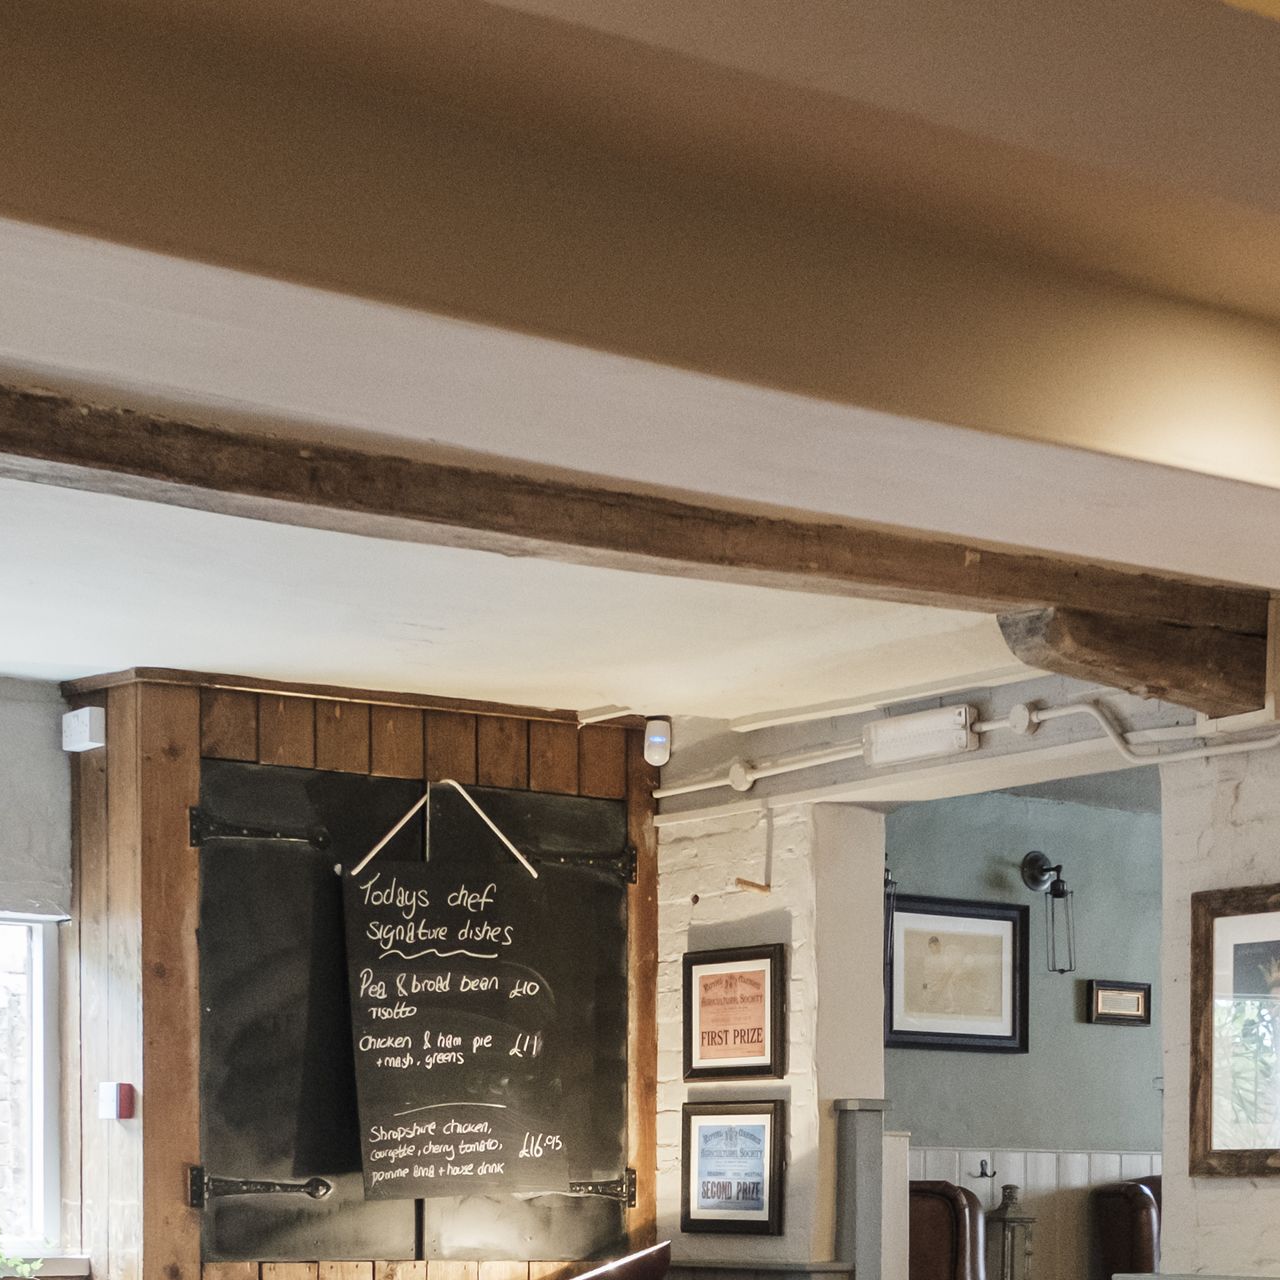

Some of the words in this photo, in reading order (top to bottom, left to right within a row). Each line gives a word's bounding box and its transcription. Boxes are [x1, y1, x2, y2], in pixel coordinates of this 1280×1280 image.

[360, 873, 430, 919] Todays
[448, 883, 497, 912] chef
[458, 920, 513, 945] dishes
[360, 968, 387, 999] Pea
[396, 973, 408, 996] &
[411, 972, 451, 993] broad
[460, 975, 499, 992] bean
[509, 980, 540, 999] £10
[368, 1001, 418, 1020] risotto
[359, 1034, 412, 1051] Chicken
[423, 1030, 431, 1050] &
[437, 1033, 462, 1048] ham
[473, 1035, 493, 1053] pie
[701, 1030, 729, 1047] FIRST
[733, 1027, 763, 1045] PRIZE
[425, 1052, 464, 1069] greens
[369, 1121, 437, 1143] Shropshire
[477, 1161, 505, 1176] drink
[701, 1181, 732, 1200] SECOND
[736, 1181, 761, 1200] PRIZE
